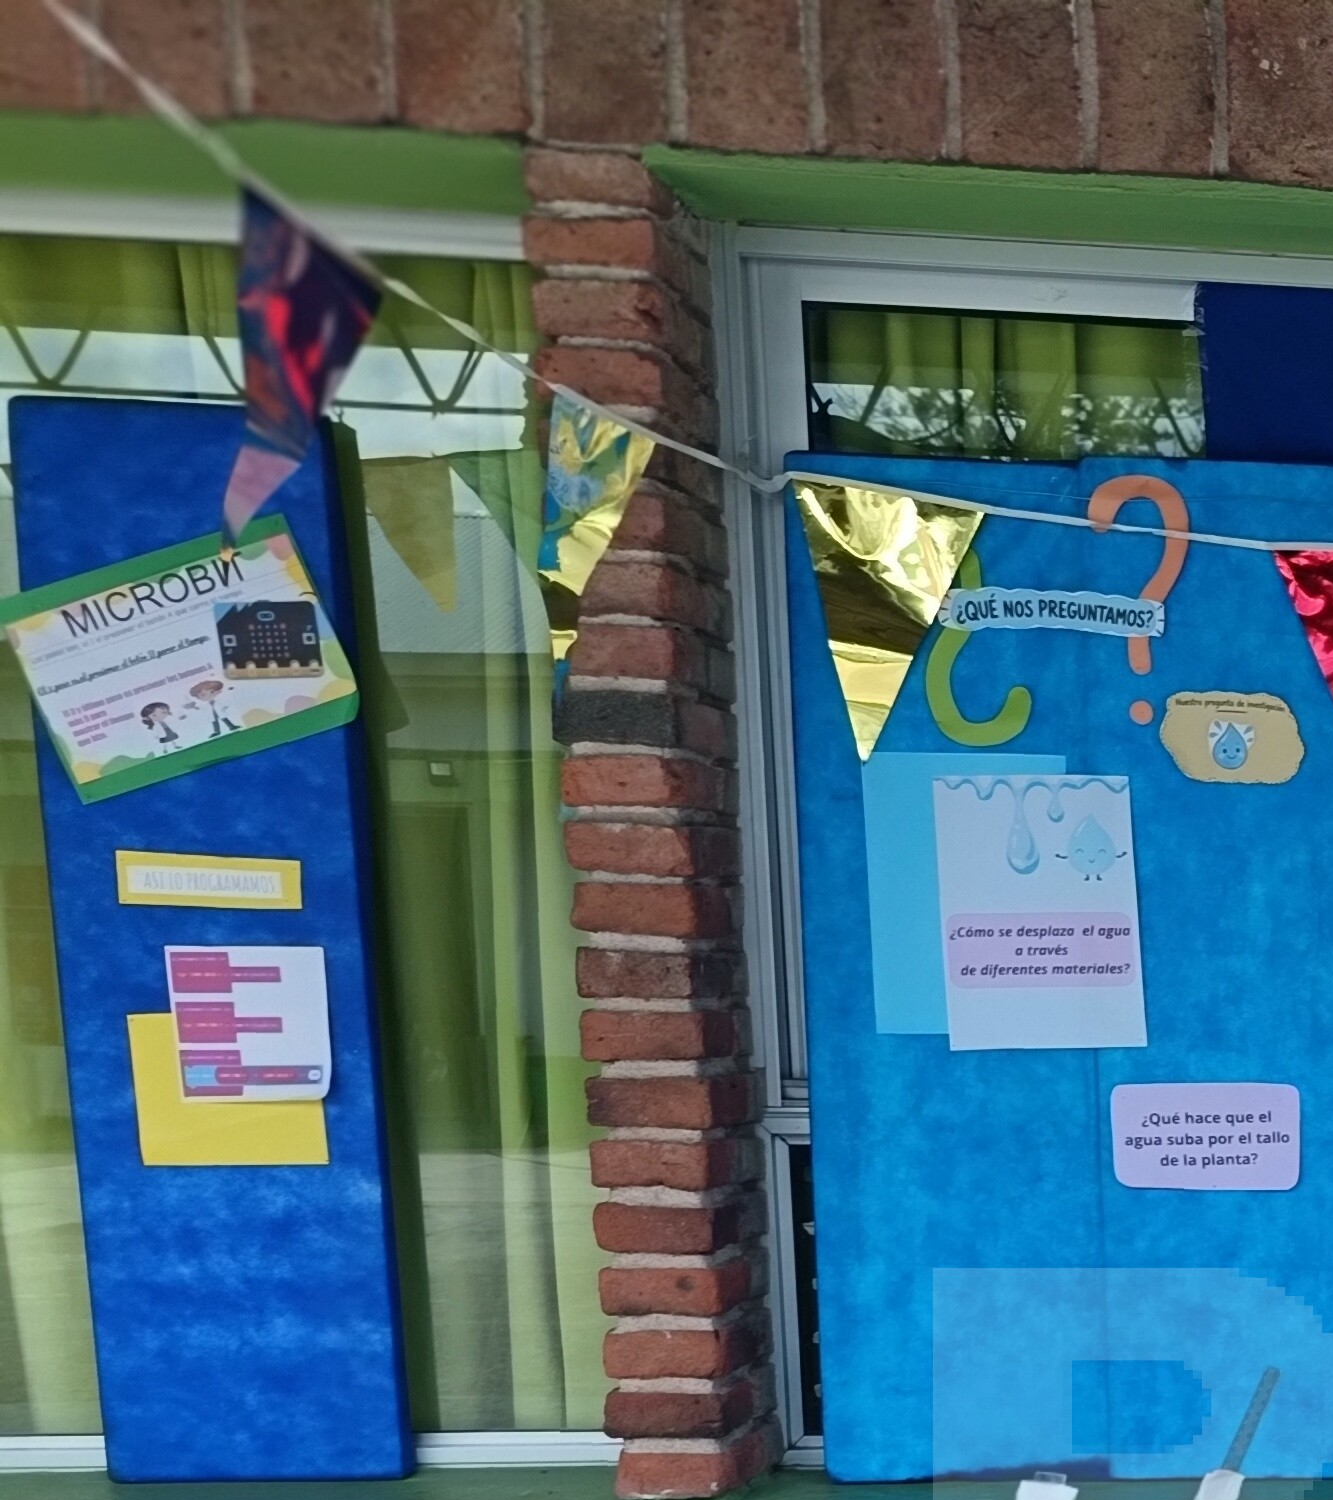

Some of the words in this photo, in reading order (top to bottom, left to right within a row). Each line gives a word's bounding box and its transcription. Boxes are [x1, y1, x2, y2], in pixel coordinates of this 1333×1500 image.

[956, 593, 998, 624] ¿QUÉ
[1003, 600, 1033, 618] NOS
[1039, 600, 1153, 628] PREGUNTAMOS?
[950, 926, 994, 940] ¿Cómo
[999, 929, 1012, 937] se
[1016, 926, 1074, 939] desplaza
[1083, 926, 1094, 936] el
[1098, 928, 1130, 938] agua
[1015, 946, 1023, 955] a
[1028, 945, 1068, 955] través
[961, 965, 976, 975] de
[981, 964, 1048, 978] diferentes
[1052, 963, 1130, 974] materiales?
[1142, 1113, 1180, 1127] ¿Qué
[1185, 1113, 1221, 1123] hace
[1226, 1113, 1253, 1126] que
[1259, 1111, 1271, 1122] el
[1125, 1136, 1162, 1149] agua
[1167, 1134, 1203, 1145] suba
[1208, 1134, 1234, 1147] por
[1239, 1133, 1251, 1144] el
[1257, 1132, 1289, 1143] tallo
[1160, 1154, 1178, 1166] de
[1184, 1154, 1196, 1165] la
[1202, 1153, 1258, 1168] planta?
